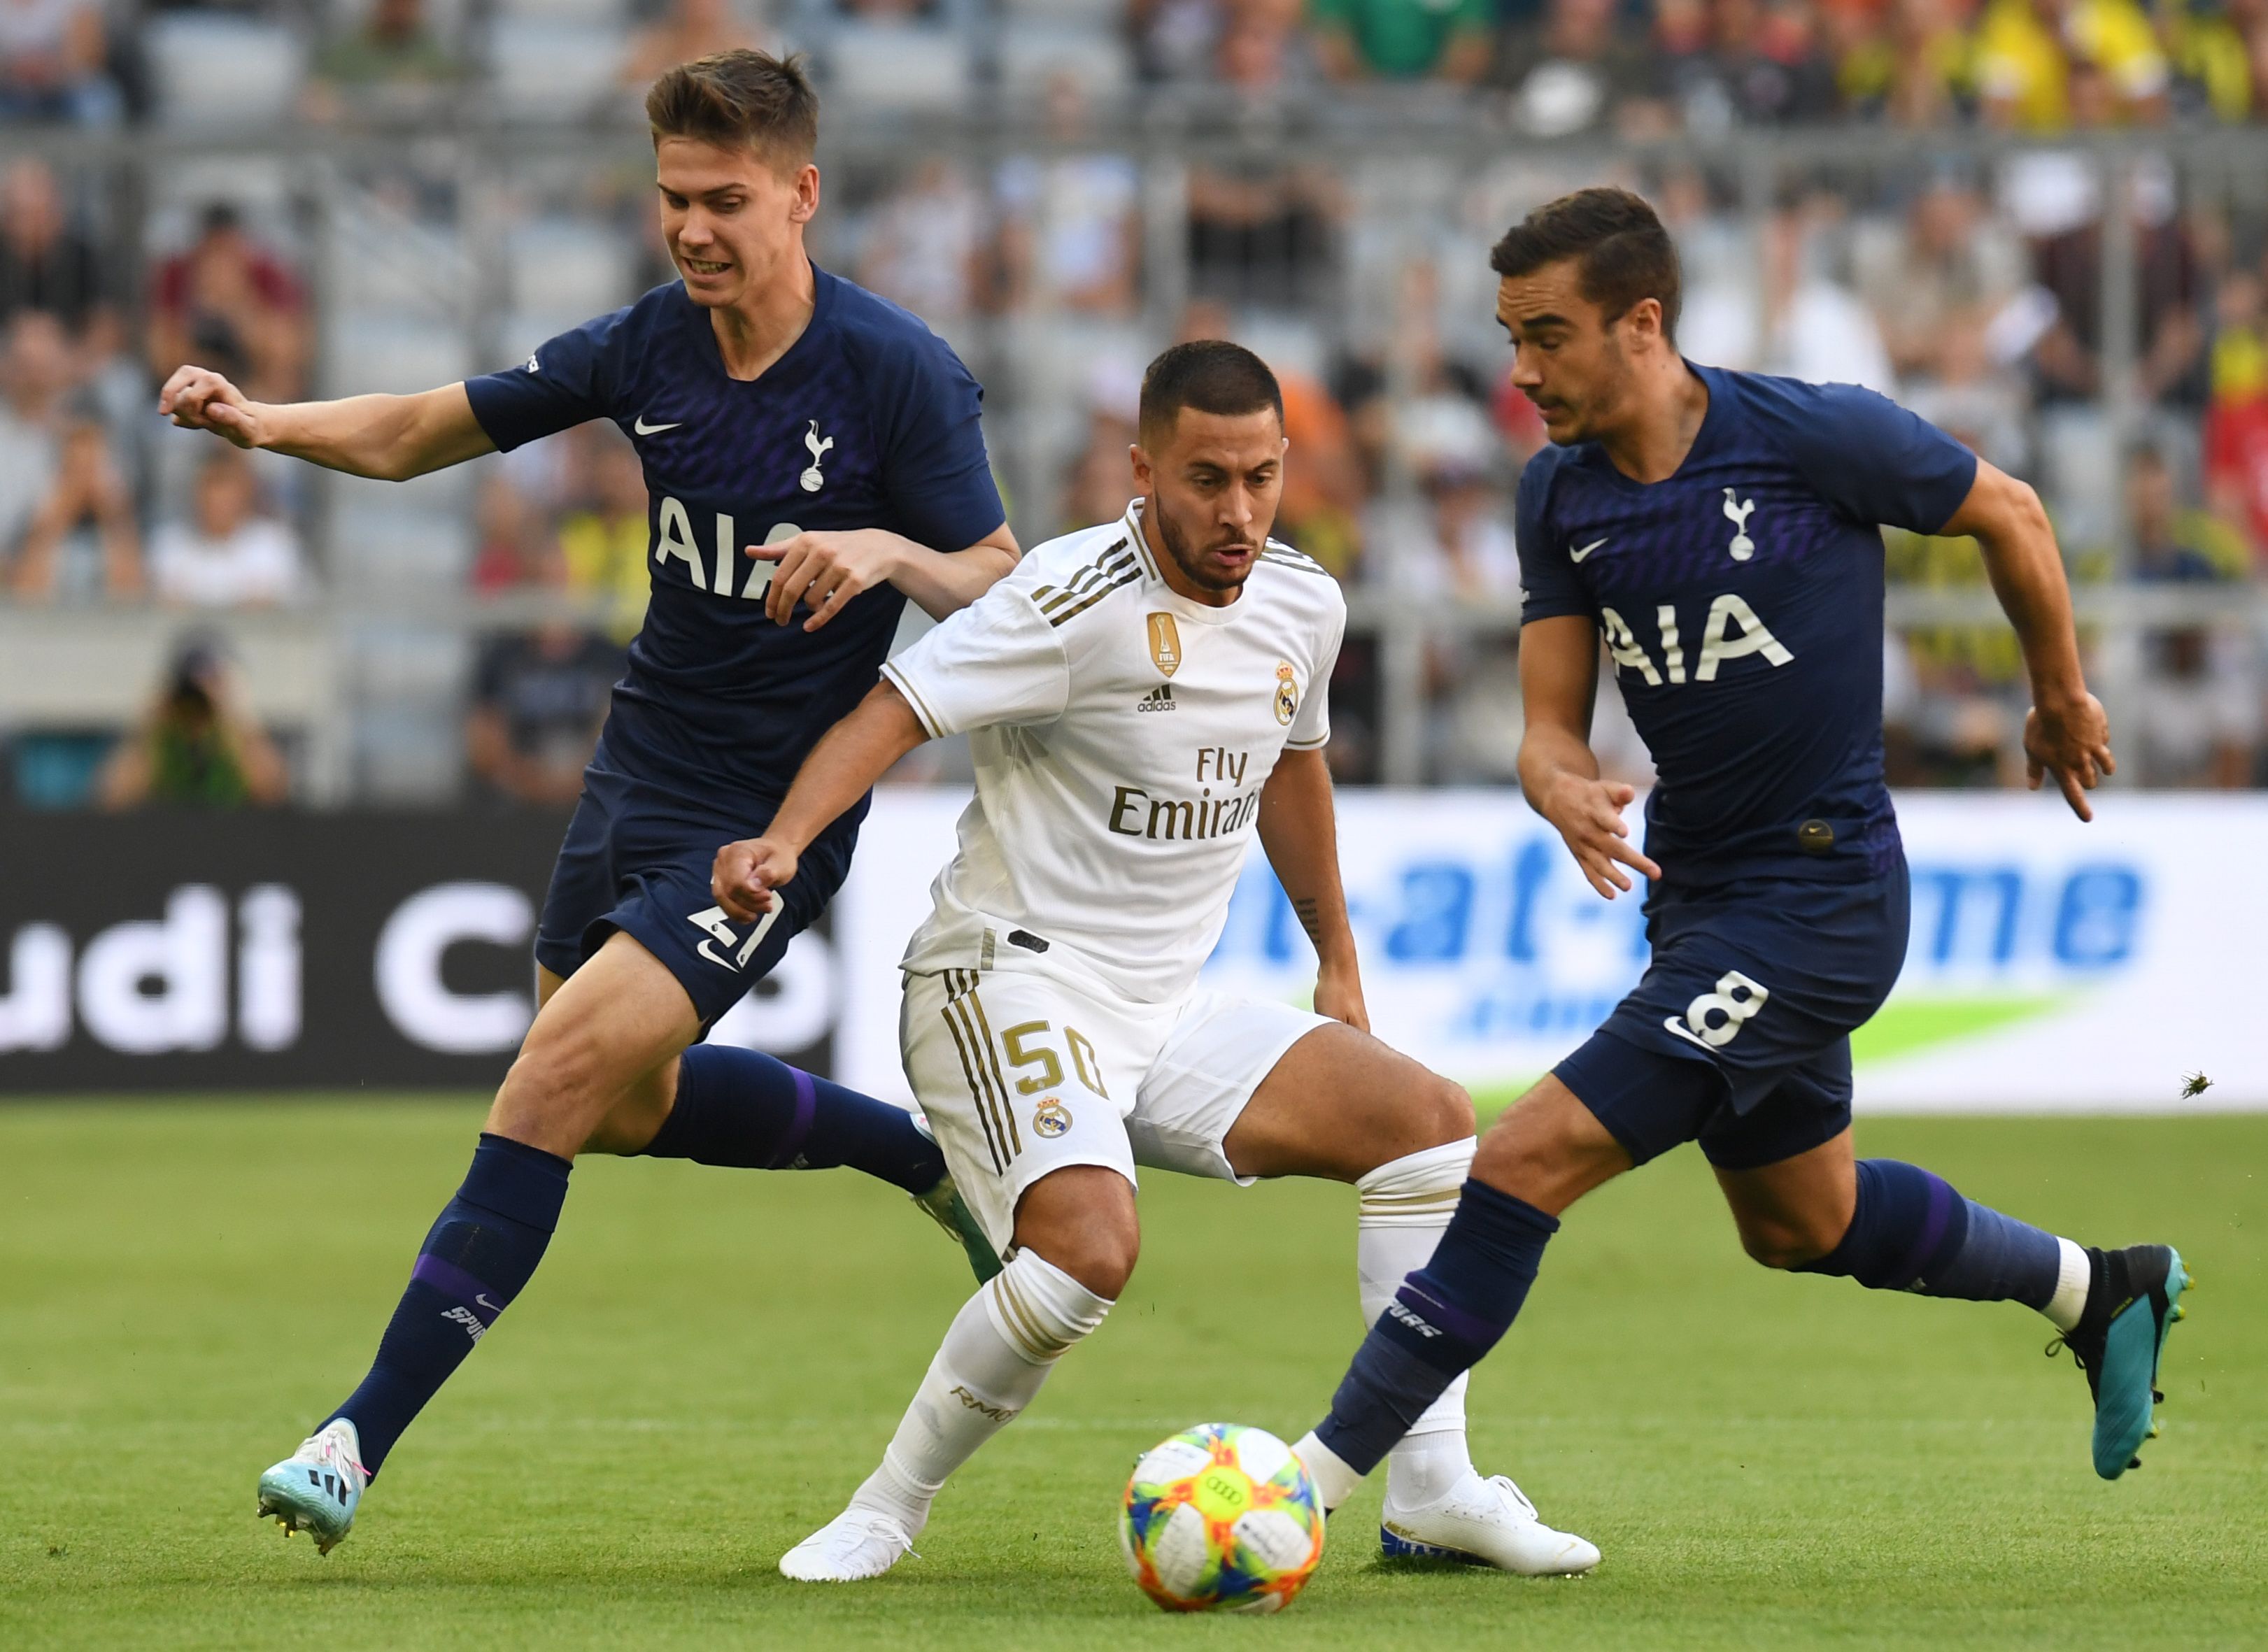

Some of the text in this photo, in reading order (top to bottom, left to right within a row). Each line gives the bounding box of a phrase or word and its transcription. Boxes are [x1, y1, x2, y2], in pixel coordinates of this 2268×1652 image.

[1599, 594, 1795, 686] AIA
[1137, 699, 1177, 713] adidas
[1196, 747, 1248, 788] Fly
[1686, 969, 1769, 1047] 8
[1000, 1020, 1111, 1102] 50
